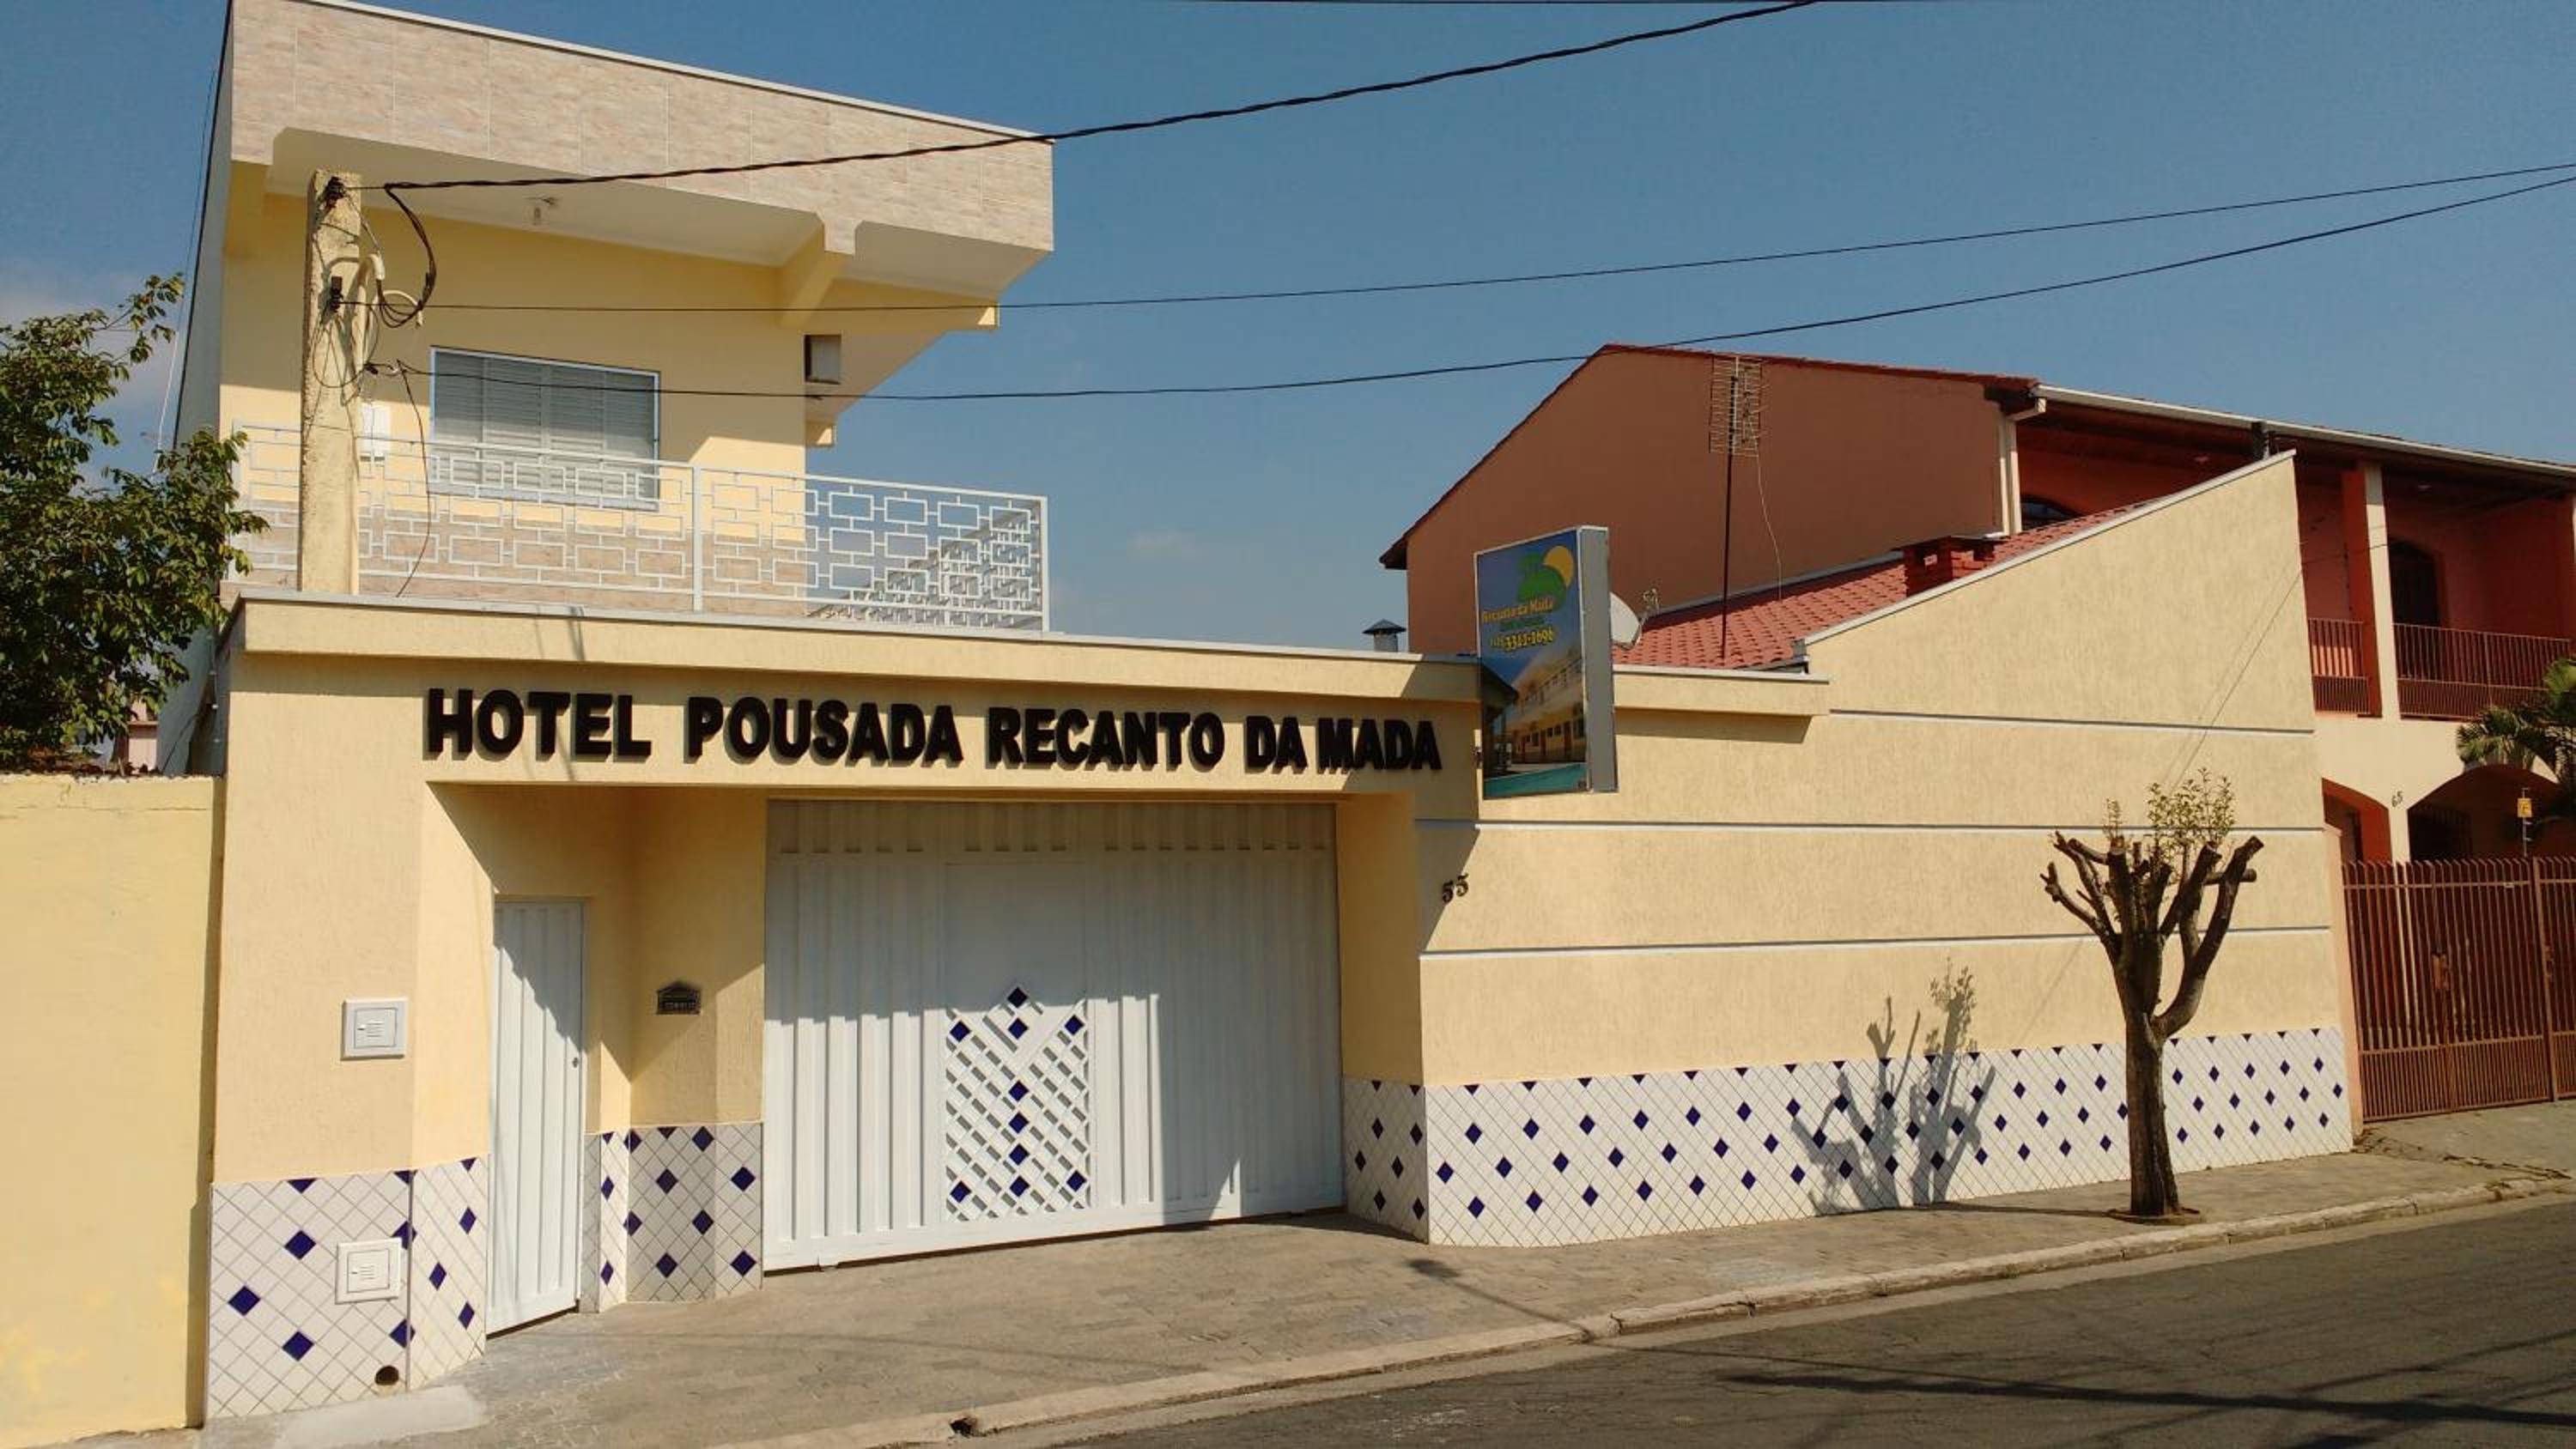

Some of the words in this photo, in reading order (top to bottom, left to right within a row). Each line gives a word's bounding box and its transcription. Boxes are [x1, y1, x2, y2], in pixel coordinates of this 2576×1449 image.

[428, 688, 652, 757] HOTEL
[687, 696, 963, 762] POUSADA
[988, 706, 1225, 769] RECANTO
[1245, 716, 1308, 769] DA
[1318, 717, 1443, 771] MADA
